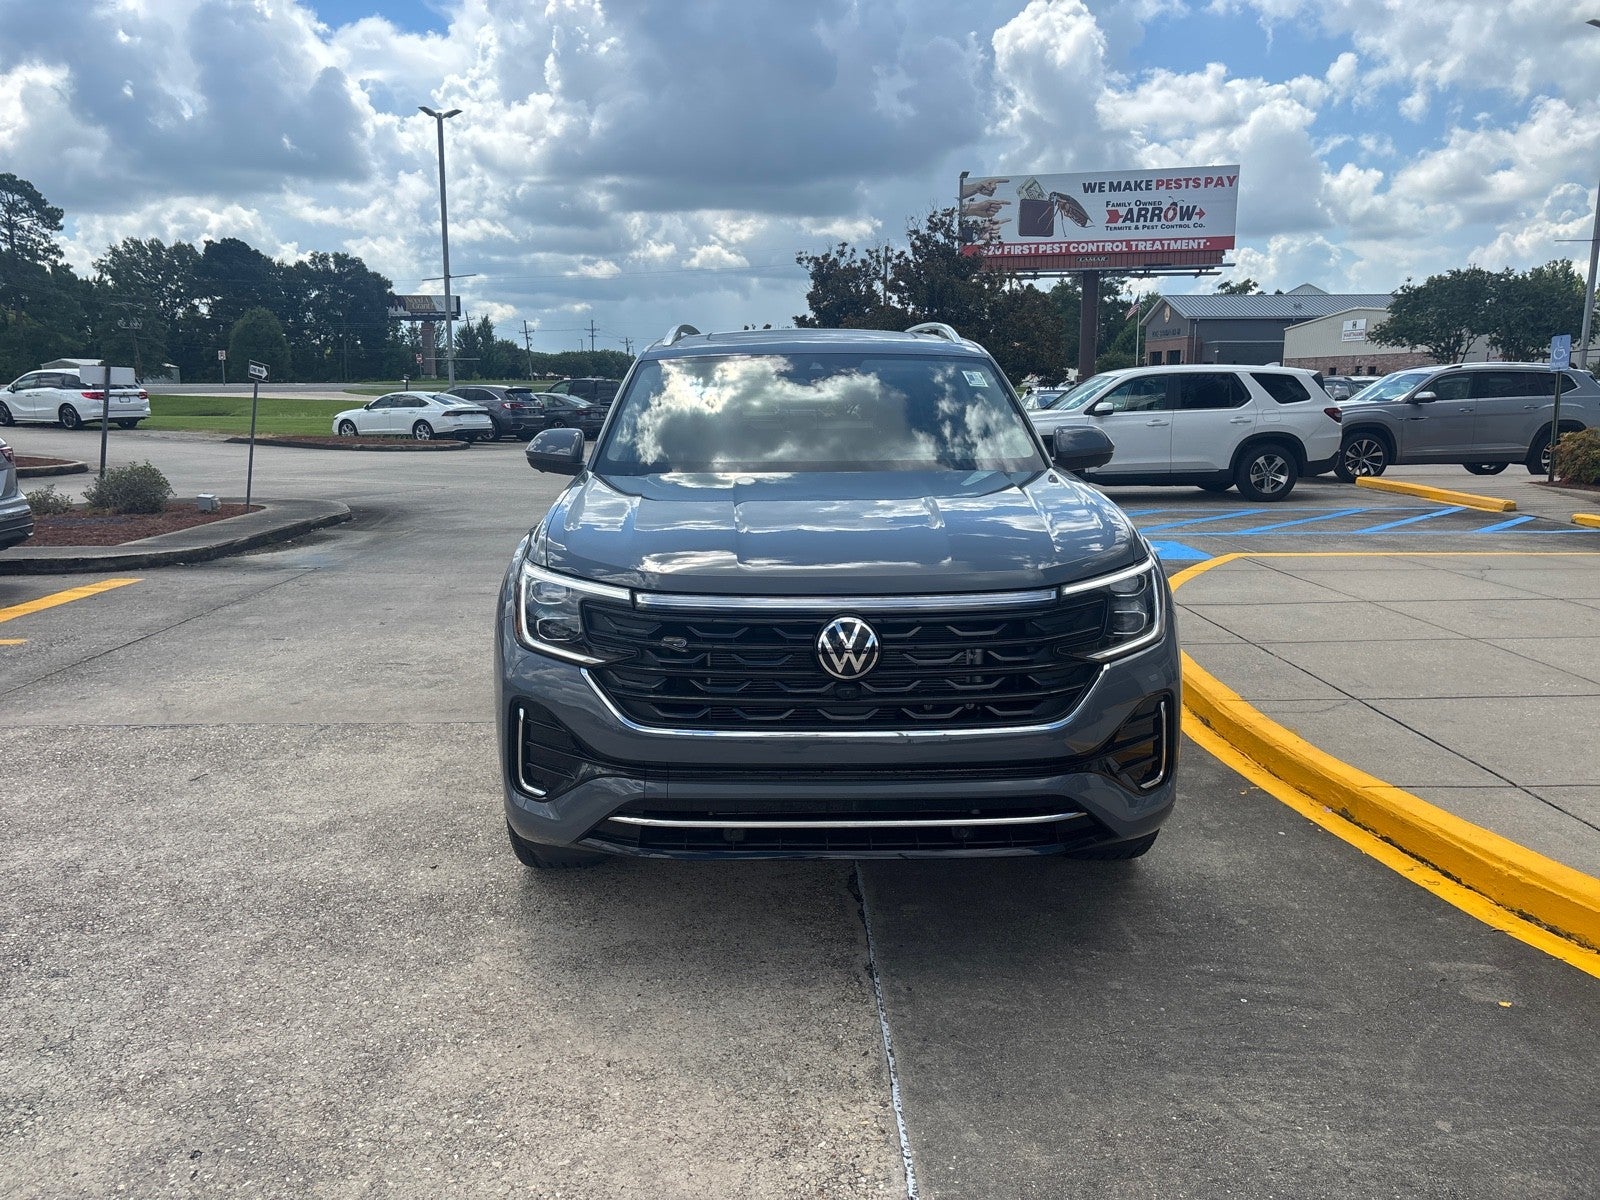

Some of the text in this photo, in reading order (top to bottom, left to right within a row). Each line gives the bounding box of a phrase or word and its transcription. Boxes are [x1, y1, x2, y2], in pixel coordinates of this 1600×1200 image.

[1082, 175, 1238, 194] WE MAKE PESTS PAY
[1121, 203, 1197, 224] ARROW
[1003, 244, 1038, 255] FIRST
[1038, 242, 1068, 254] PEST
[1069, 241, 1129, 254] CONTROL
